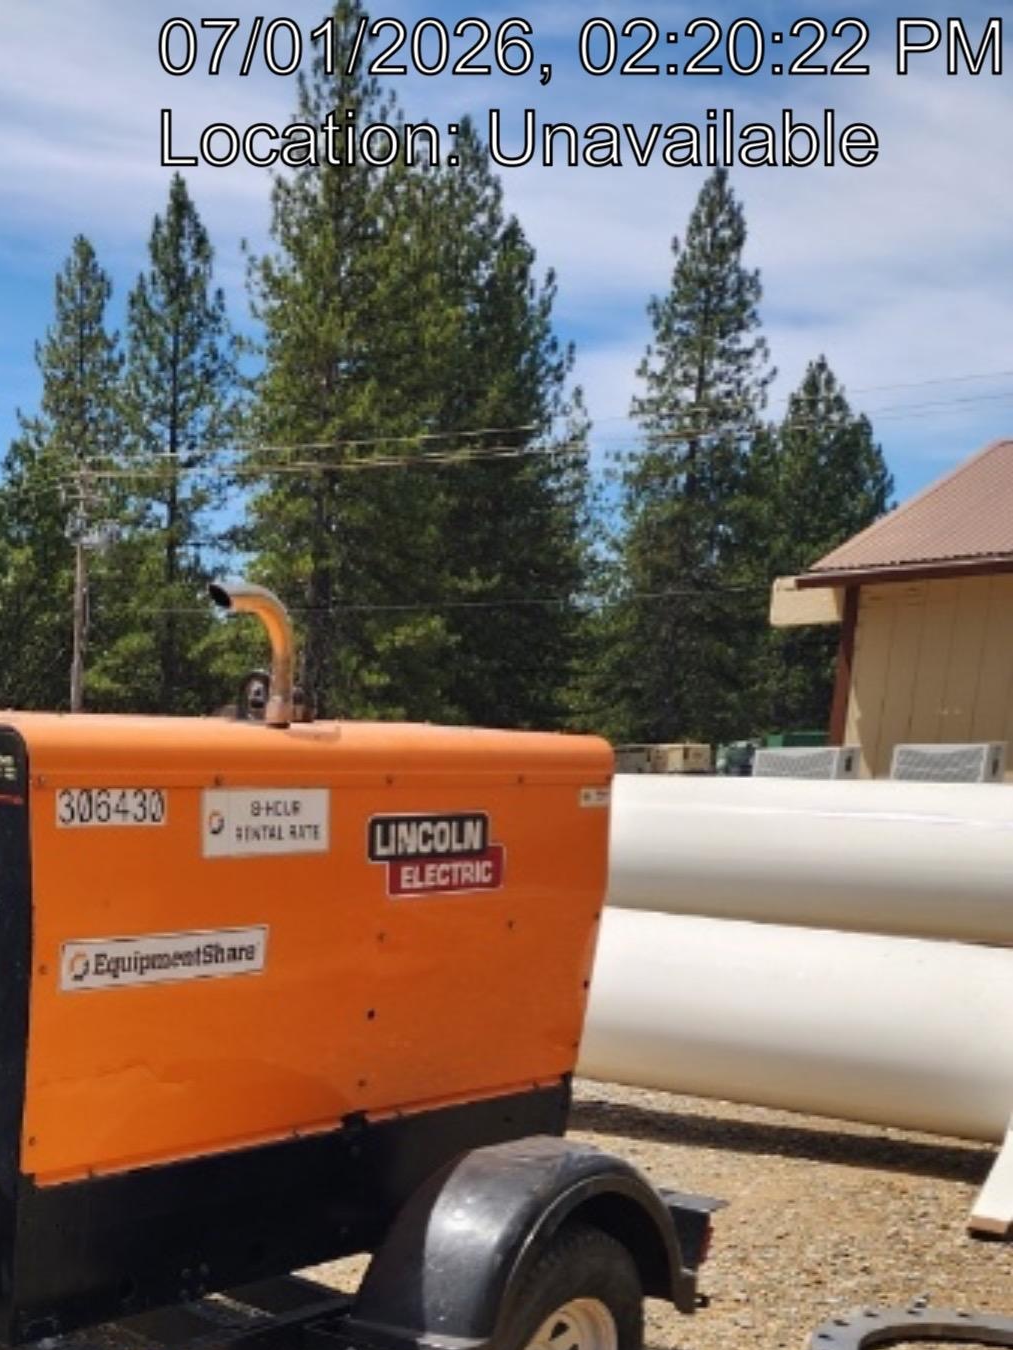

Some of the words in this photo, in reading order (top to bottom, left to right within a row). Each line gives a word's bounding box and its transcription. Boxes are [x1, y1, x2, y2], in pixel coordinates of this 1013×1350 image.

[59, 788, 166, 824] 306430
[250, 800, 300, 817] 8-HOUR
[235, 825, 285, 843] RENTAL
[289, 823, 321, 842] RATE
[375, 819, 483, 857] LINCOLN
[400, 860, 493, 889] ELECTRIC
[93, 942, 256, 978] EquipmentShare
